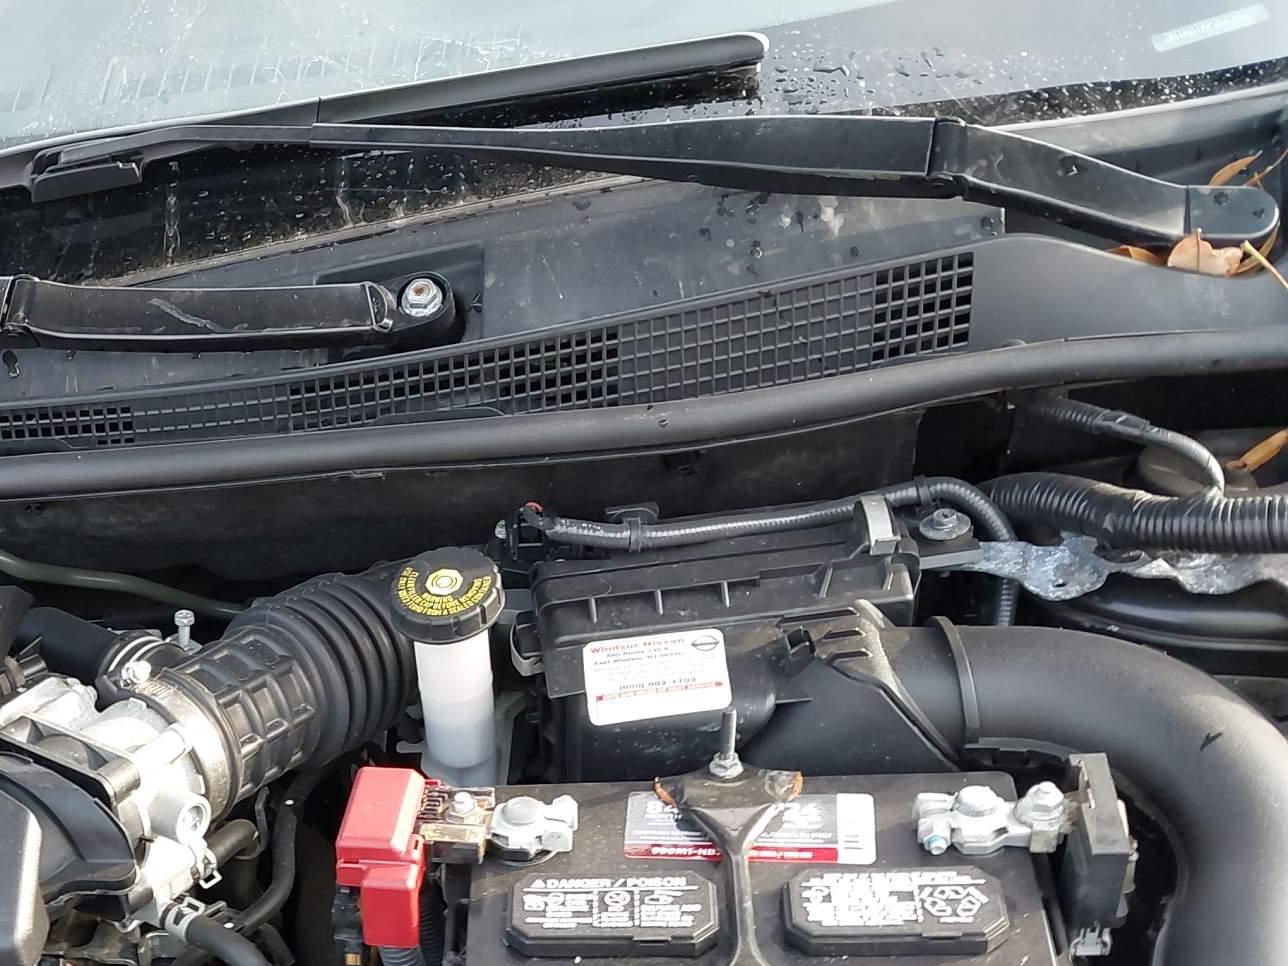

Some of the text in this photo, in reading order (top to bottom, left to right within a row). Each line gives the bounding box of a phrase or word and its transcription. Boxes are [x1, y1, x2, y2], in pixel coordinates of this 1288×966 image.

[590, 638, 685, 655] Windsor Nissan
[545, 878, 612, 888] DANGER
[627, 876, 687, 888] POISON
